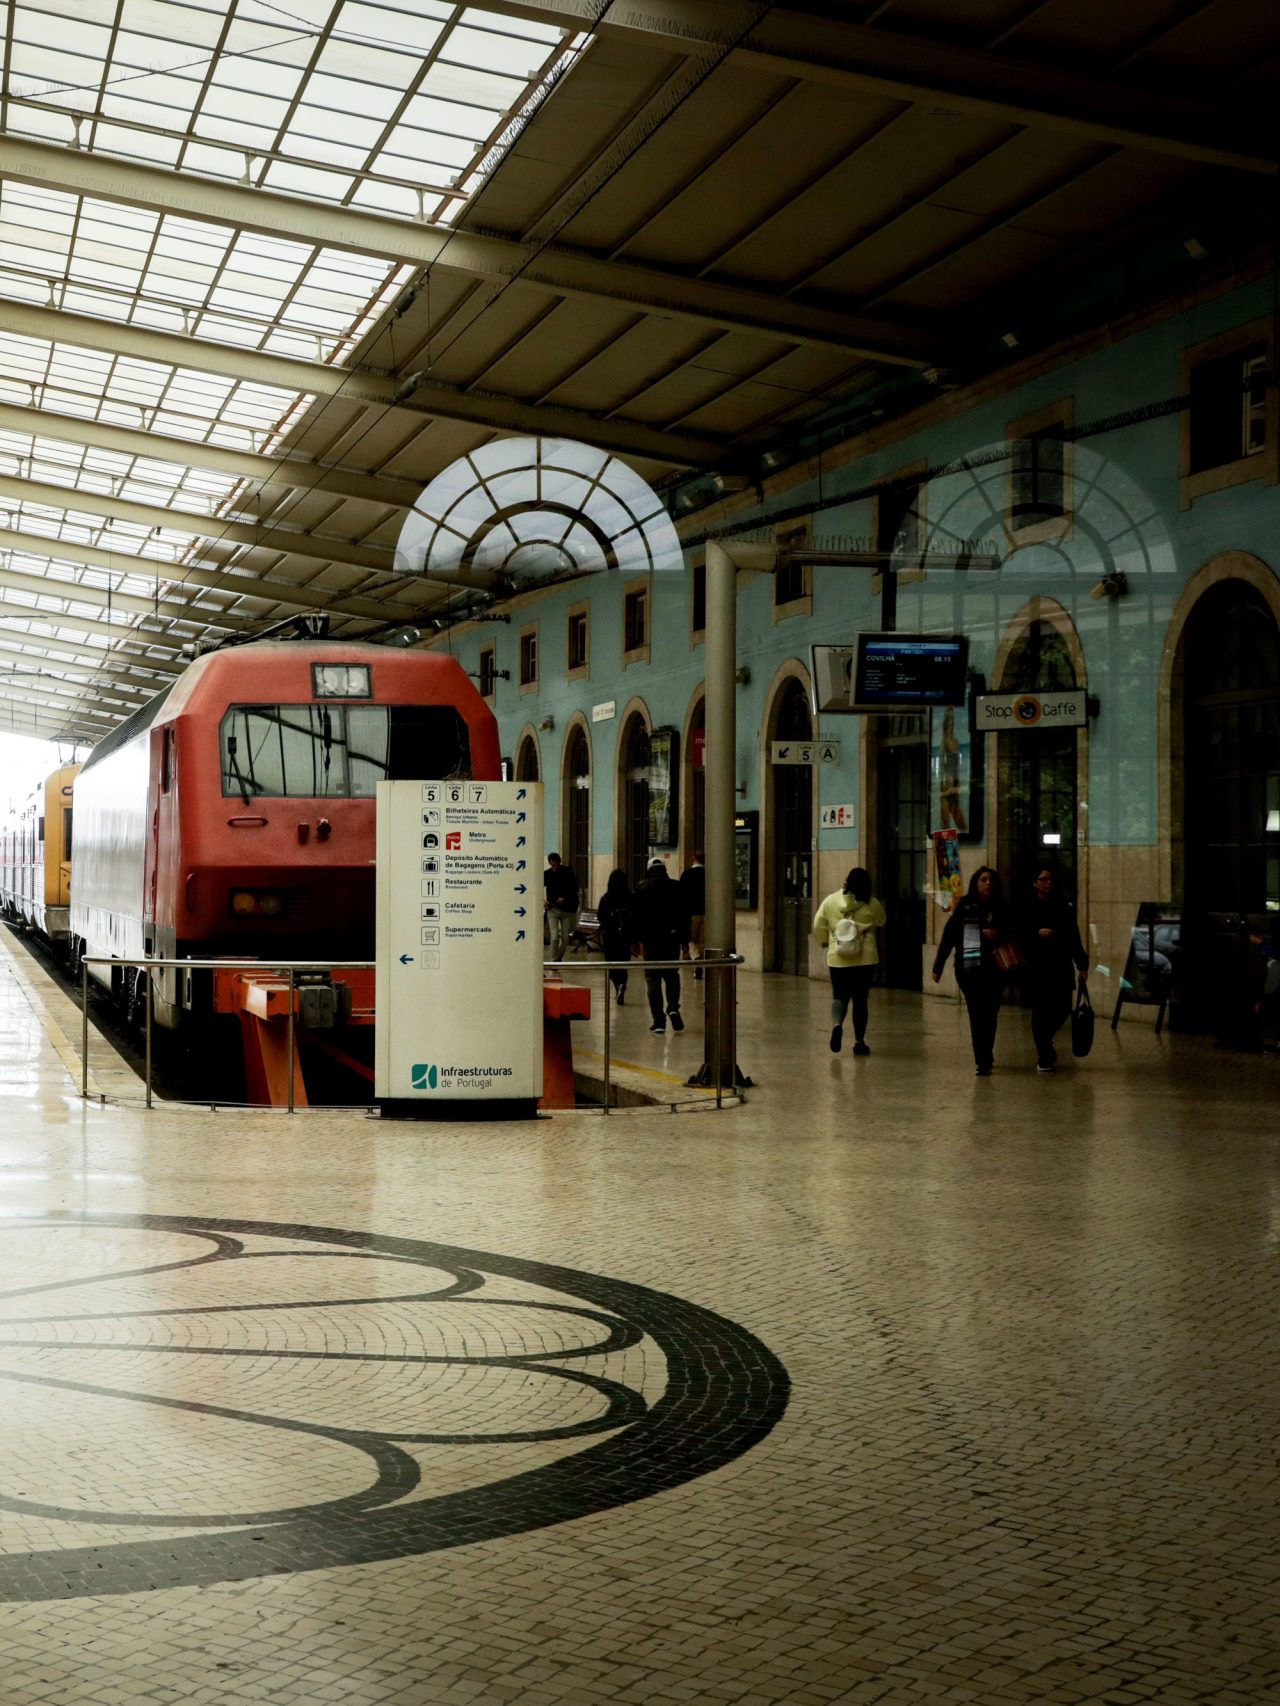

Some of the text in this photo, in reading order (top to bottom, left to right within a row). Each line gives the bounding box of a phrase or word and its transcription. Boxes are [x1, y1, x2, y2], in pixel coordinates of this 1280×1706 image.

[985, 703, 1076, 719] Stop Caffè
[802, 748, 833, 761] 5 A
[427, 790, 435, 801] 5
[451, 789, 459, 801] 6
[475, 791, 482, 802] 7
[445, 854, 473, 862] Depósito
[441, 1066, 513, 1077] Infraestruturas
[441, 1078, 492, 1090] de Portugal
